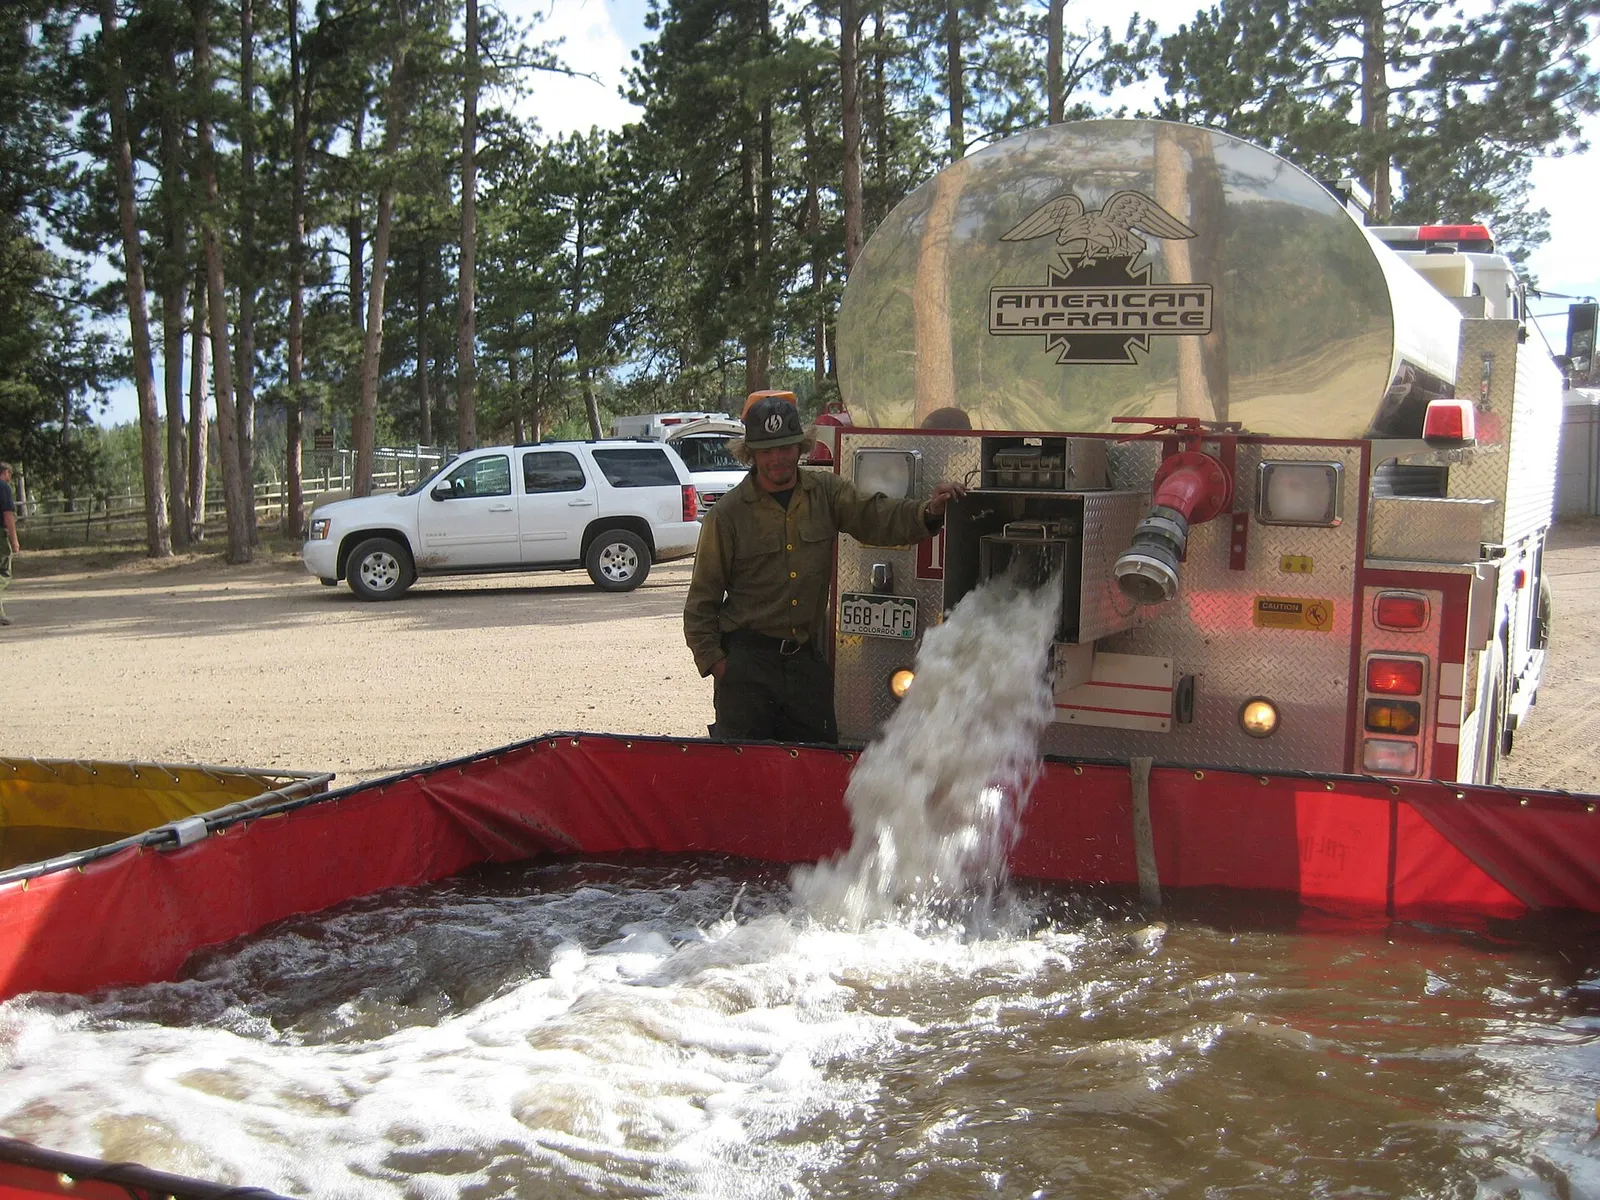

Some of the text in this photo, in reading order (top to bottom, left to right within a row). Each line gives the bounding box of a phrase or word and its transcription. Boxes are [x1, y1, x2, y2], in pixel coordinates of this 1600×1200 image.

[996, 292, 1205, 309] AMERICAN
[1262, 602, 1299, 611] CAUTION
[858, 626, 896, 635] COLORADO
